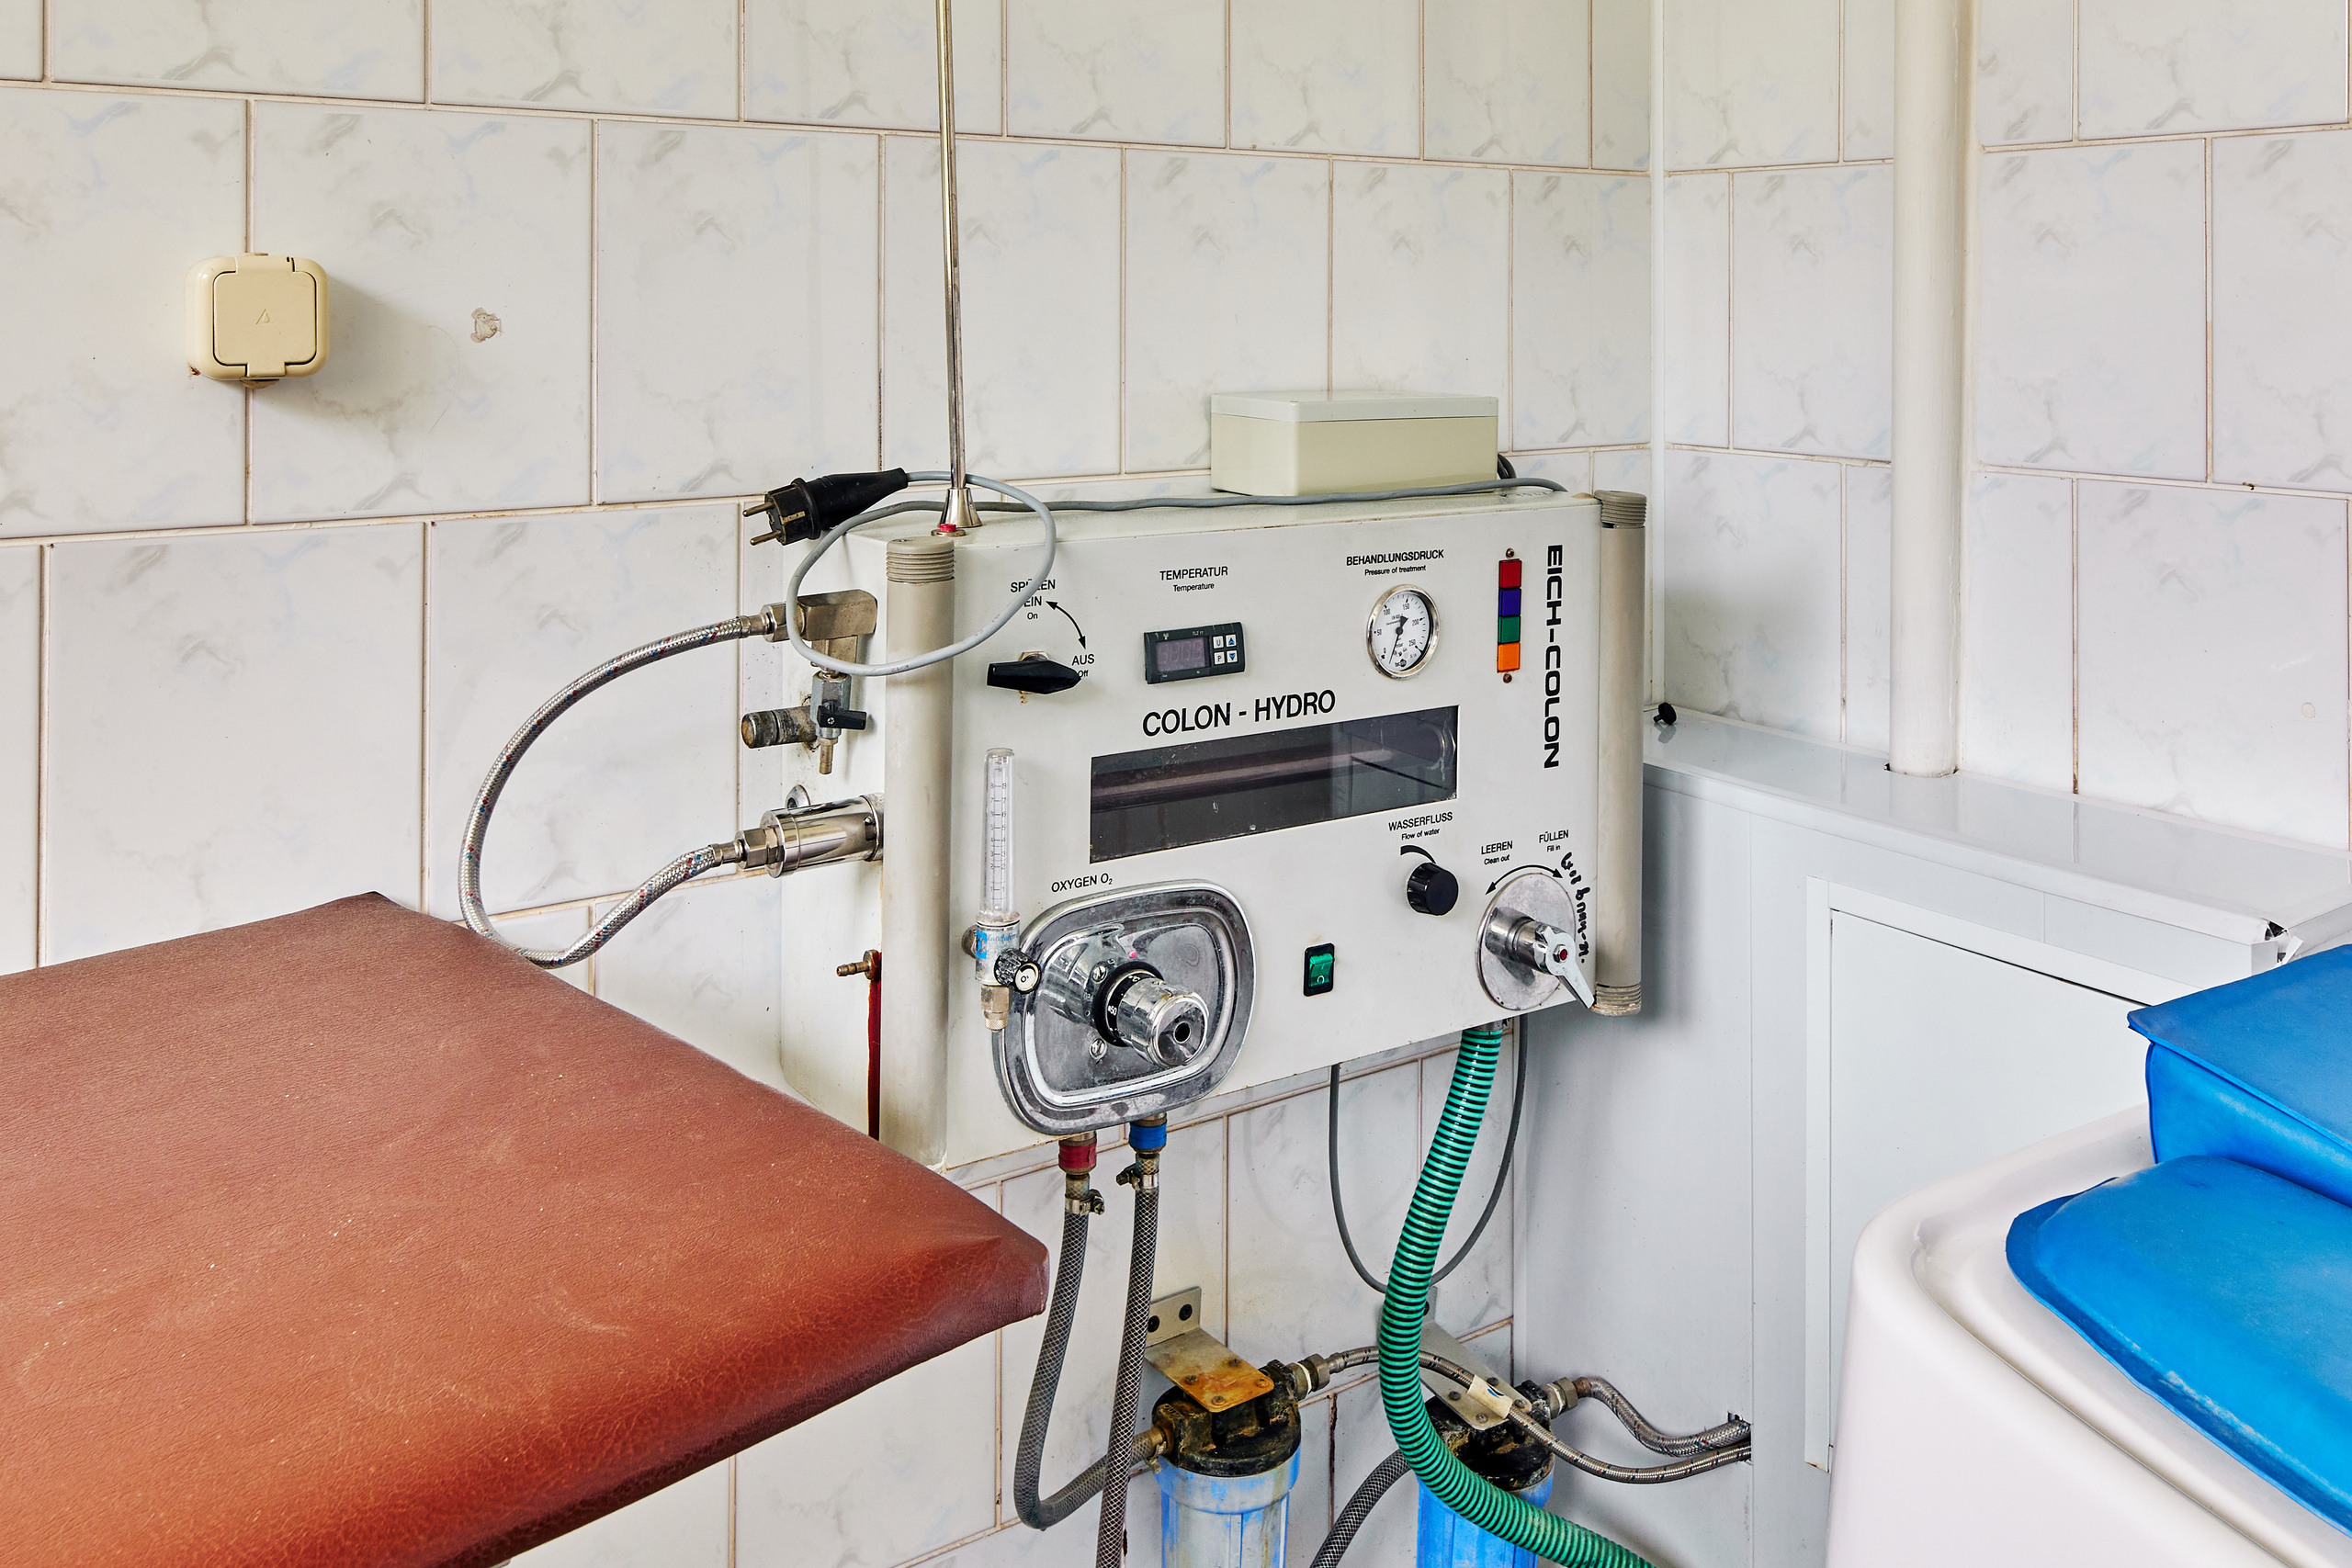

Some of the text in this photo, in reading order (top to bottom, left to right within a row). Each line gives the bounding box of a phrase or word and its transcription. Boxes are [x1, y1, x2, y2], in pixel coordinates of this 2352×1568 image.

[1346, 549, 1444, 566] BEHANDLUNGSDRUCK
[1159, 566, 1228, 581] TEMPERATUR
[1364, 567, 1390, 577] Pressure
[1398, 565, 1427, 573] treatment
[1010, 579, 1056, 593] SPEN
[1173, 582, 1215, 592] Temperature
[1383, 608, 1391, 616] 100
[1402, 603, 1410, 611] 150
[1026, 612, 1038, 620] On
[1376, 628, 1383, 637] 50
[1408, 638, 1417, 648] 250
[1071, 653, 1095, 666] AUS
[1544, 544, 1563, 769] EICH-COLON
[1078, 669, 1089, 678] Off
[1142, 702, 1231, 737] COLON
[1254, 690, 1336, 722] HYDRO
[1388, 811, 1453, 831] WASSERFLUSS
[1401, 832, 1415, 840] Flow
[1424, 829, 1441, 837] water
[1539, 829, 1569, 843] FÜLLEN
[1481, 840, 1513, 854] LEEREN
[1484, 856, 1499, 865] Clean
[1051, 874, 1098, 893] OXYGEN
